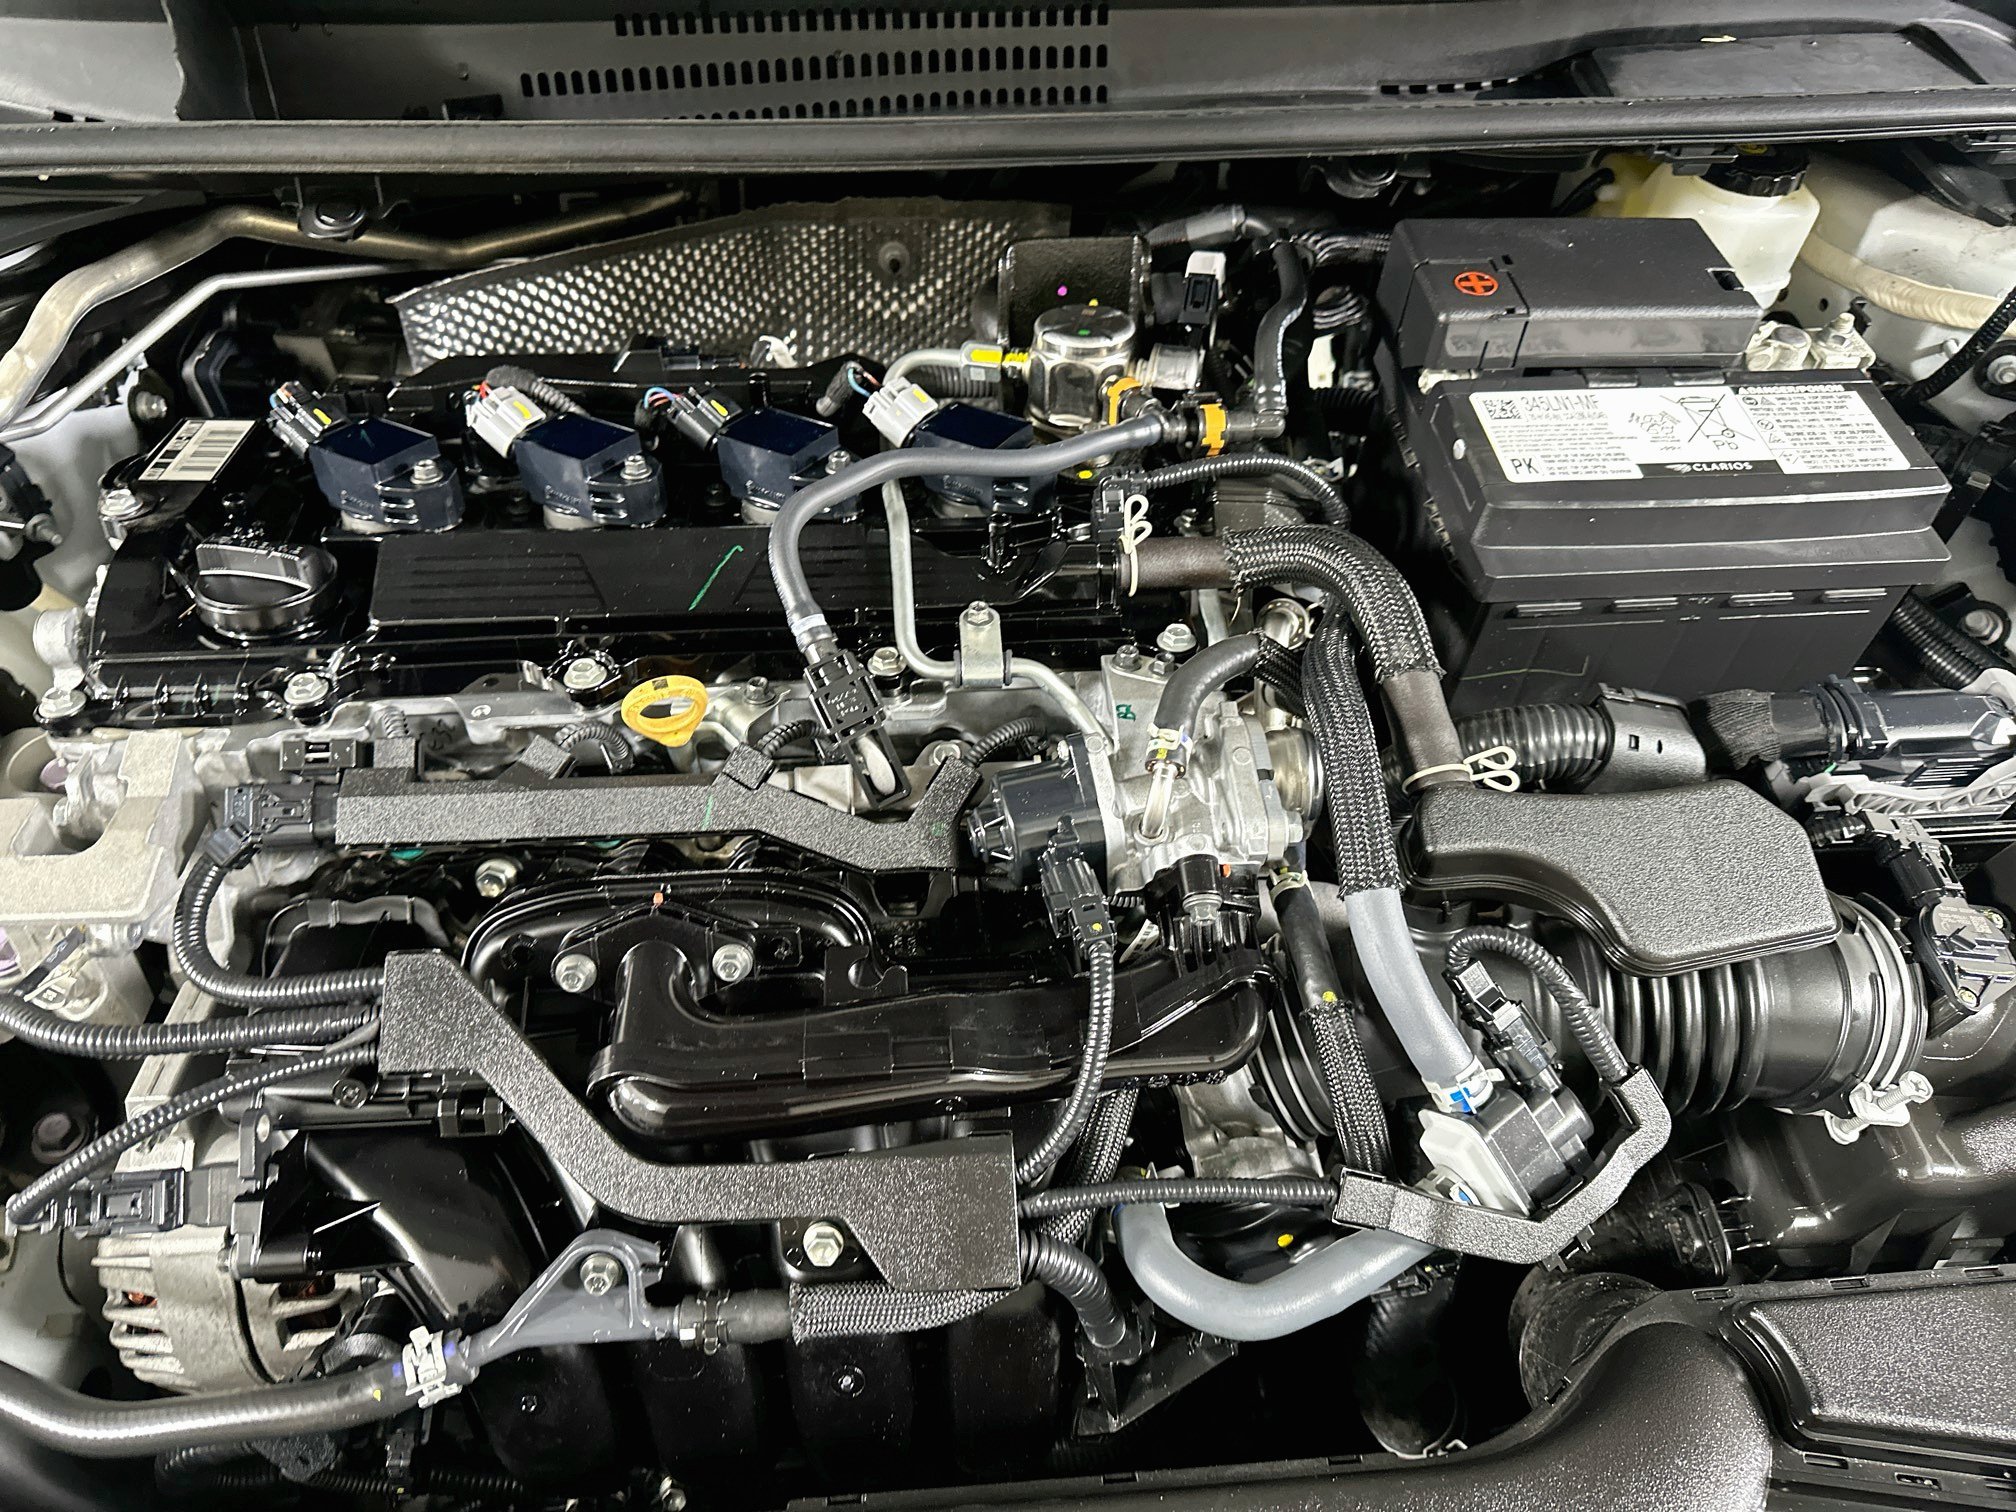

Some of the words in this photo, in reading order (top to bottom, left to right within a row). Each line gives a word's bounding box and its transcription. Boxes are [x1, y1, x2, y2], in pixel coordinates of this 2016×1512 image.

[1520, 394, 1600, 412] 345LN1-MF
[1712, 440, 1739, 451] Pb
[1510, 457, 1540, 475] PK
[1692, 461, 1753, 472] CLARIOS
